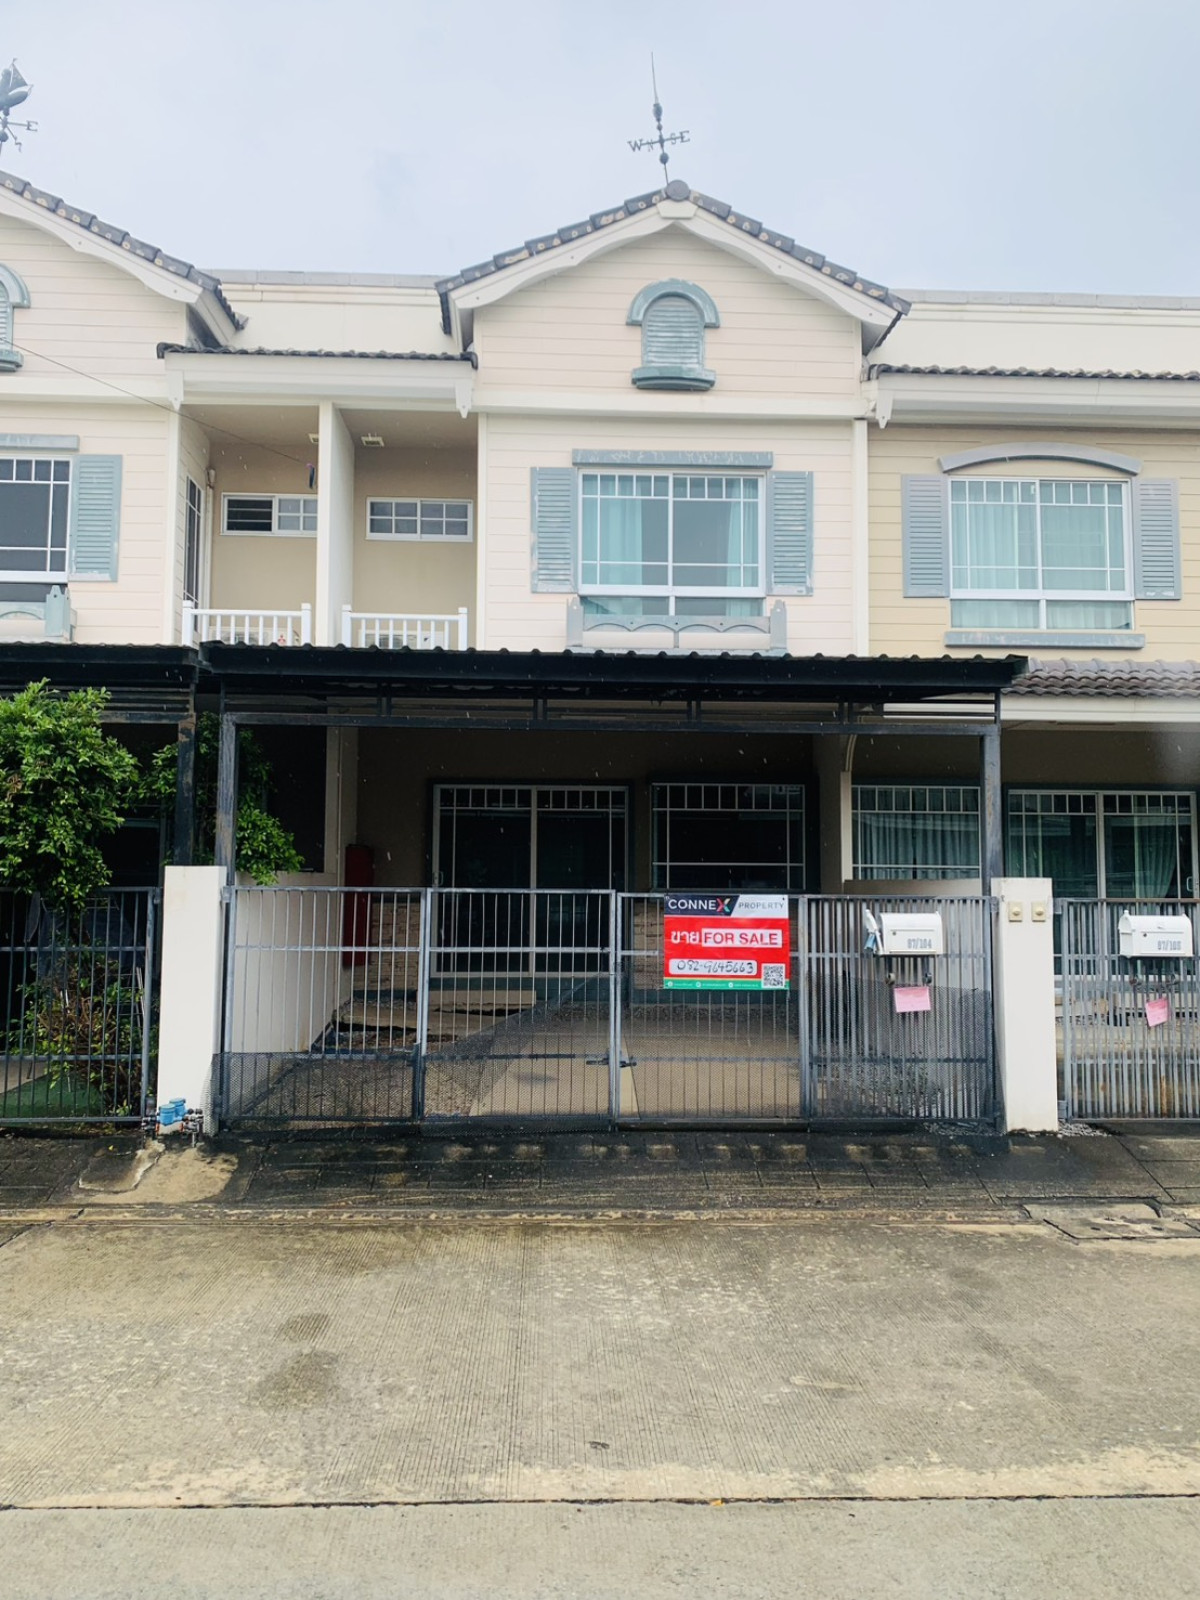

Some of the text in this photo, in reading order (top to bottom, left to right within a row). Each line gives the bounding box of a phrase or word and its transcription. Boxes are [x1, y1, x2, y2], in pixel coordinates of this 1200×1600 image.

[627, 138, 643, 152] W
[679, 130, 691, 143] E
[668, 898, 784, 912] CONNEX PROPERTY
[671, 931, 778, 945] ขาย FOR SALE
